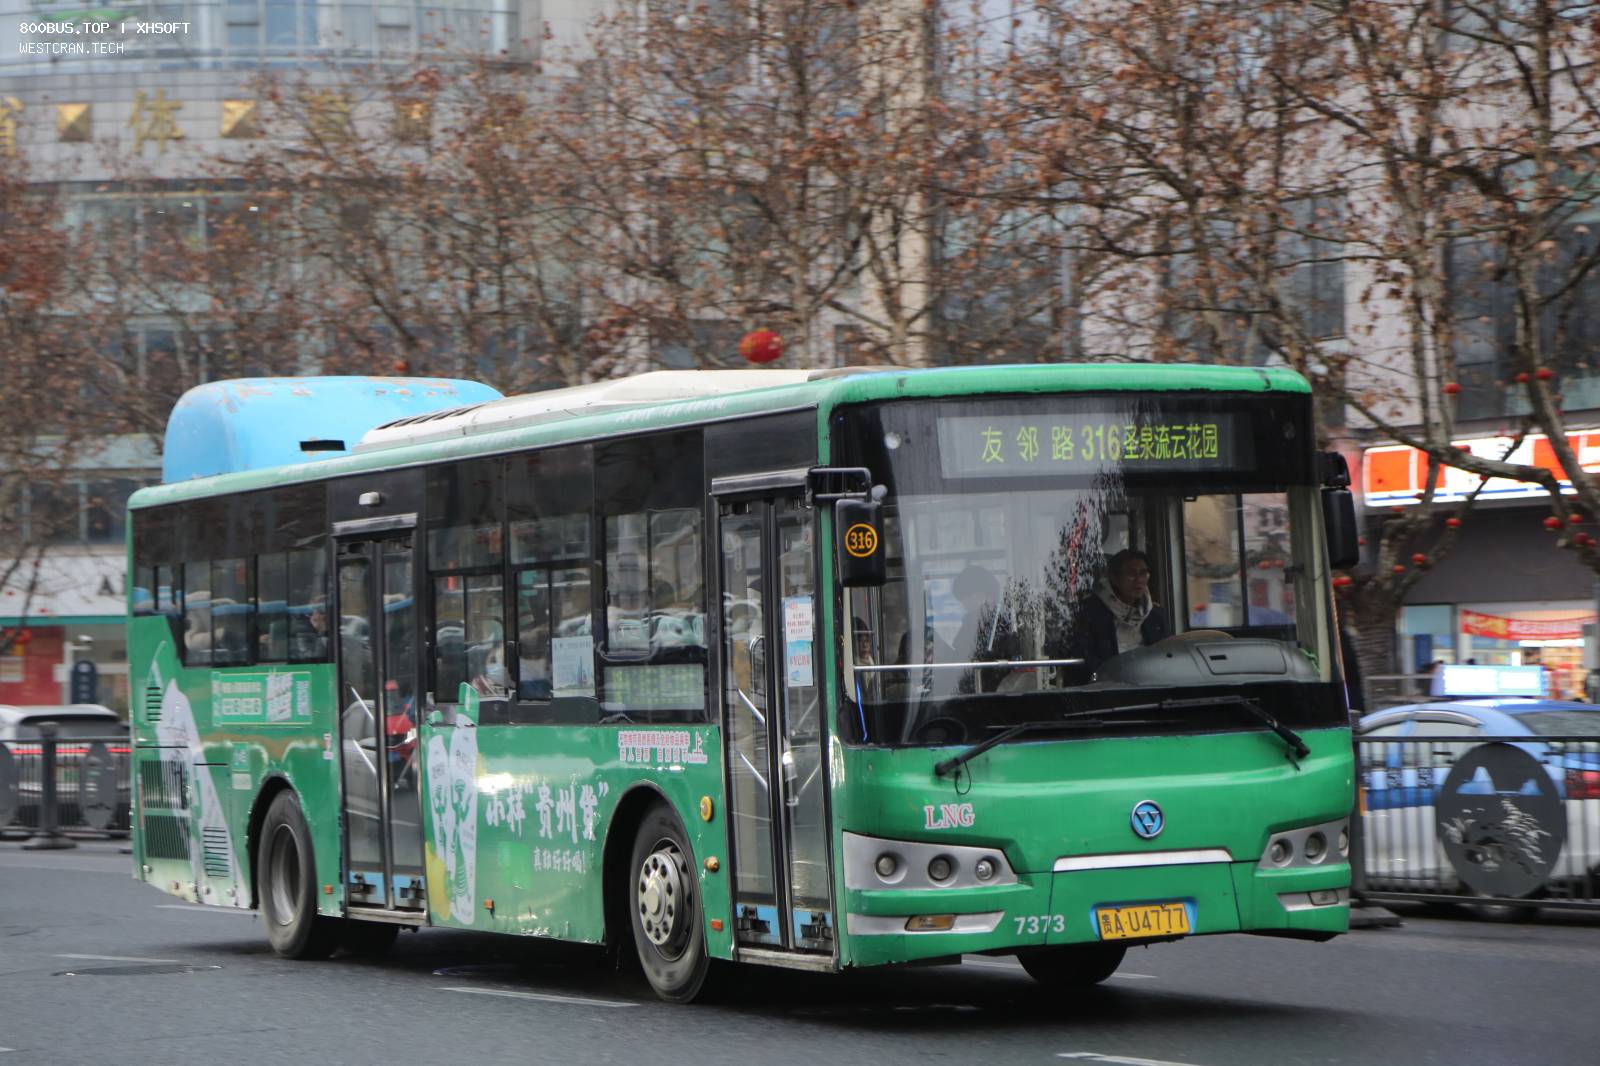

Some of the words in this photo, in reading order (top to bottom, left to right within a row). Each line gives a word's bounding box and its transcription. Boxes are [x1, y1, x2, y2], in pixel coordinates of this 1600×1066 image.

[850, 531, 873, 550] 316
[924, 803, 976, 829] LNG
[1014, 914, 1066, 935] 7373
